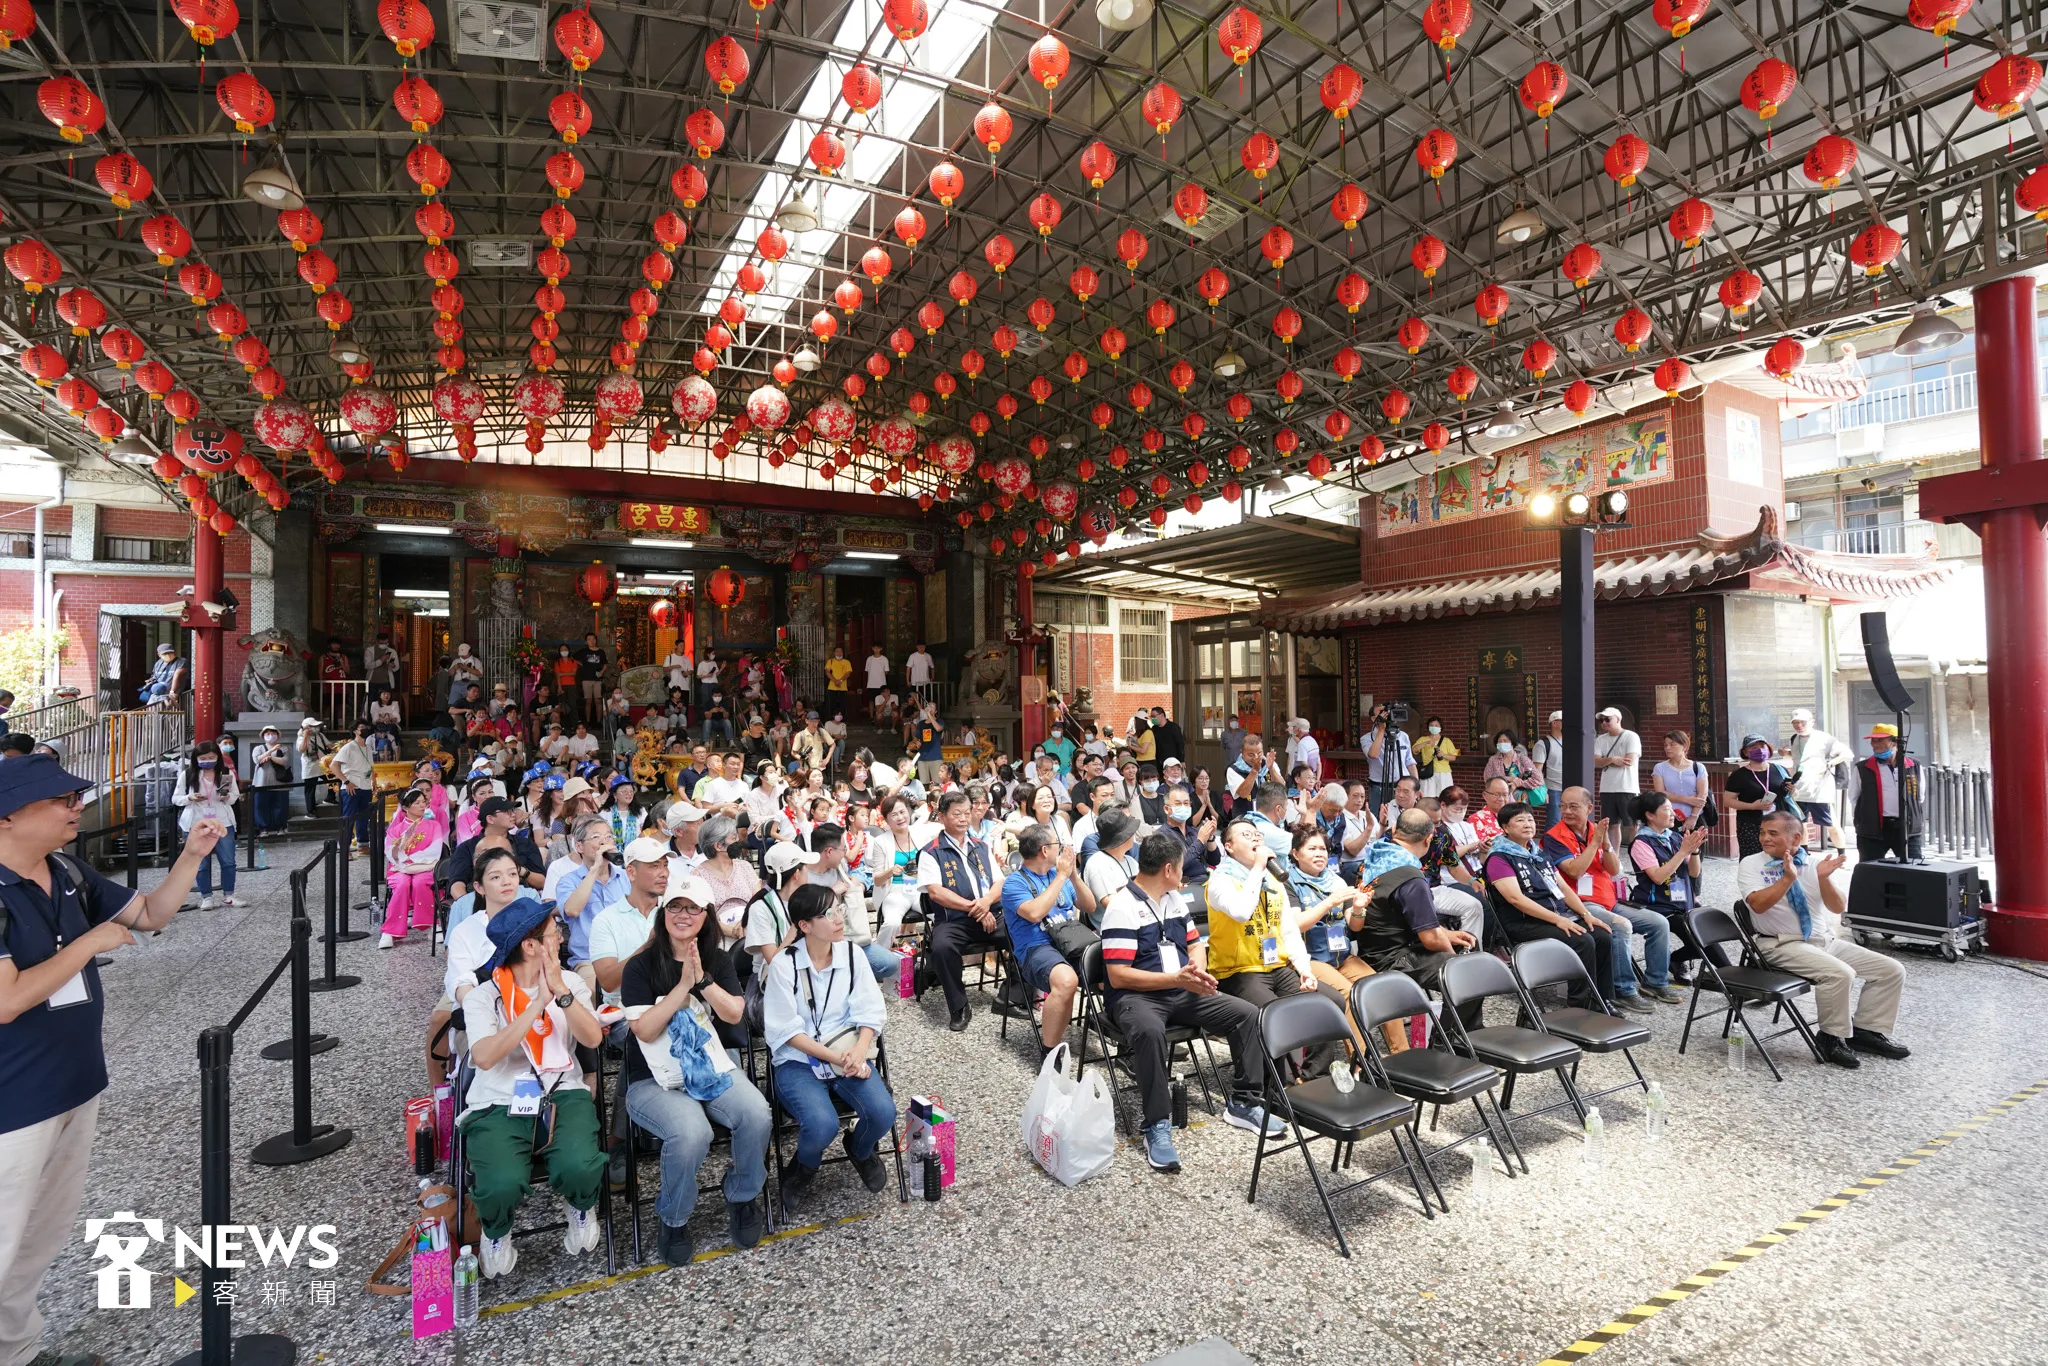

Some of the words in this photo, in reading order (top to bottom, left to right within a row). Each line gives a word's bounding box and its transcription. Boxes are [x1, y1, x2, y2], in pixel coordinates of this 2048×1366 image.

[187, 424, 232, 465] 忠
[630, 503, 699, 529] 惠昌宮
[1482, 650, 1519, 671] 金亭
